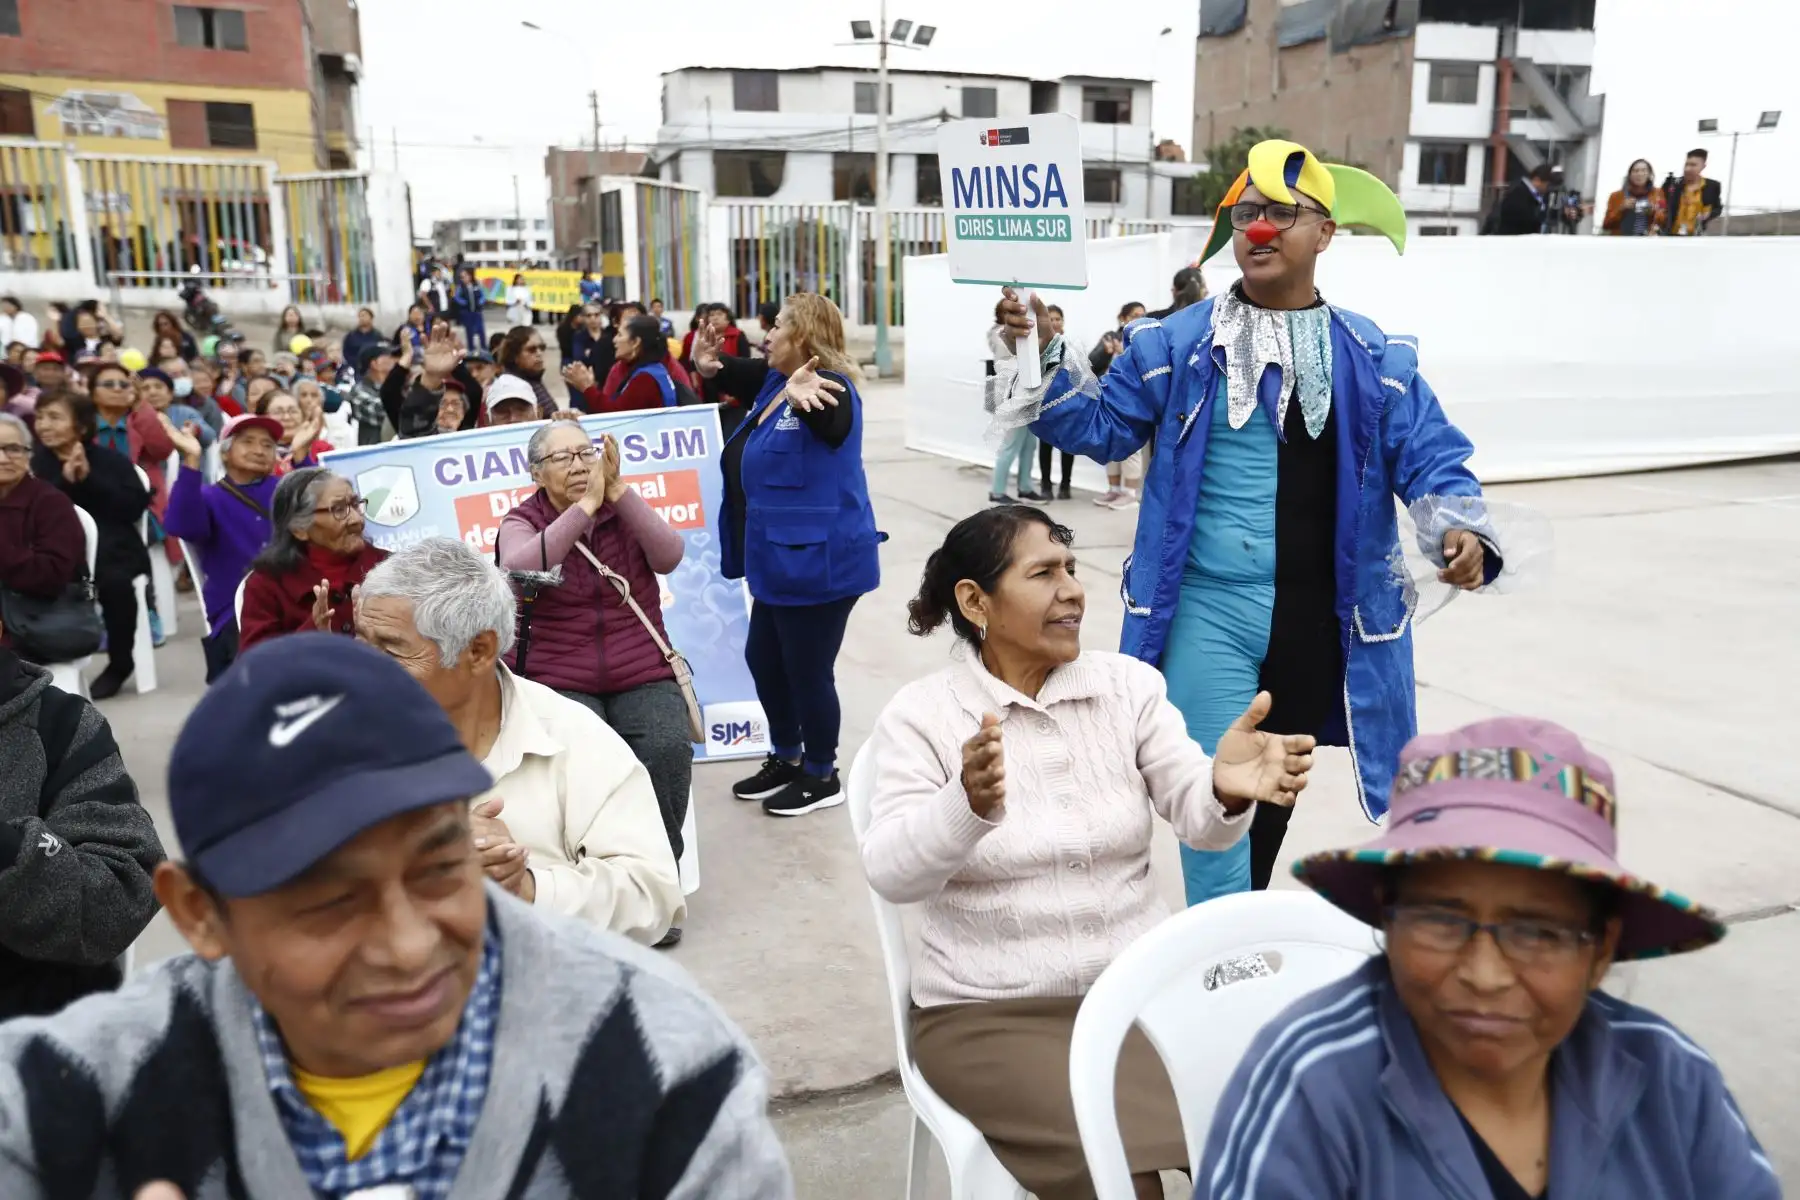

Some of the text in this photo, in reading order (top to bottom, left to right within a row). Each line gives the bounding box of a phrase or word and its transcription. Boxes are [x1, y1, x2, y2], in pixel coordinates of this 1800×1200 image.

[951, 163, 1068, 208] MINSA
[959, 218, 1068, 238] DIRIS LIMA SUR
[624, 428, 706, 462] SJM
[711, 720, 751, 745] SJM
